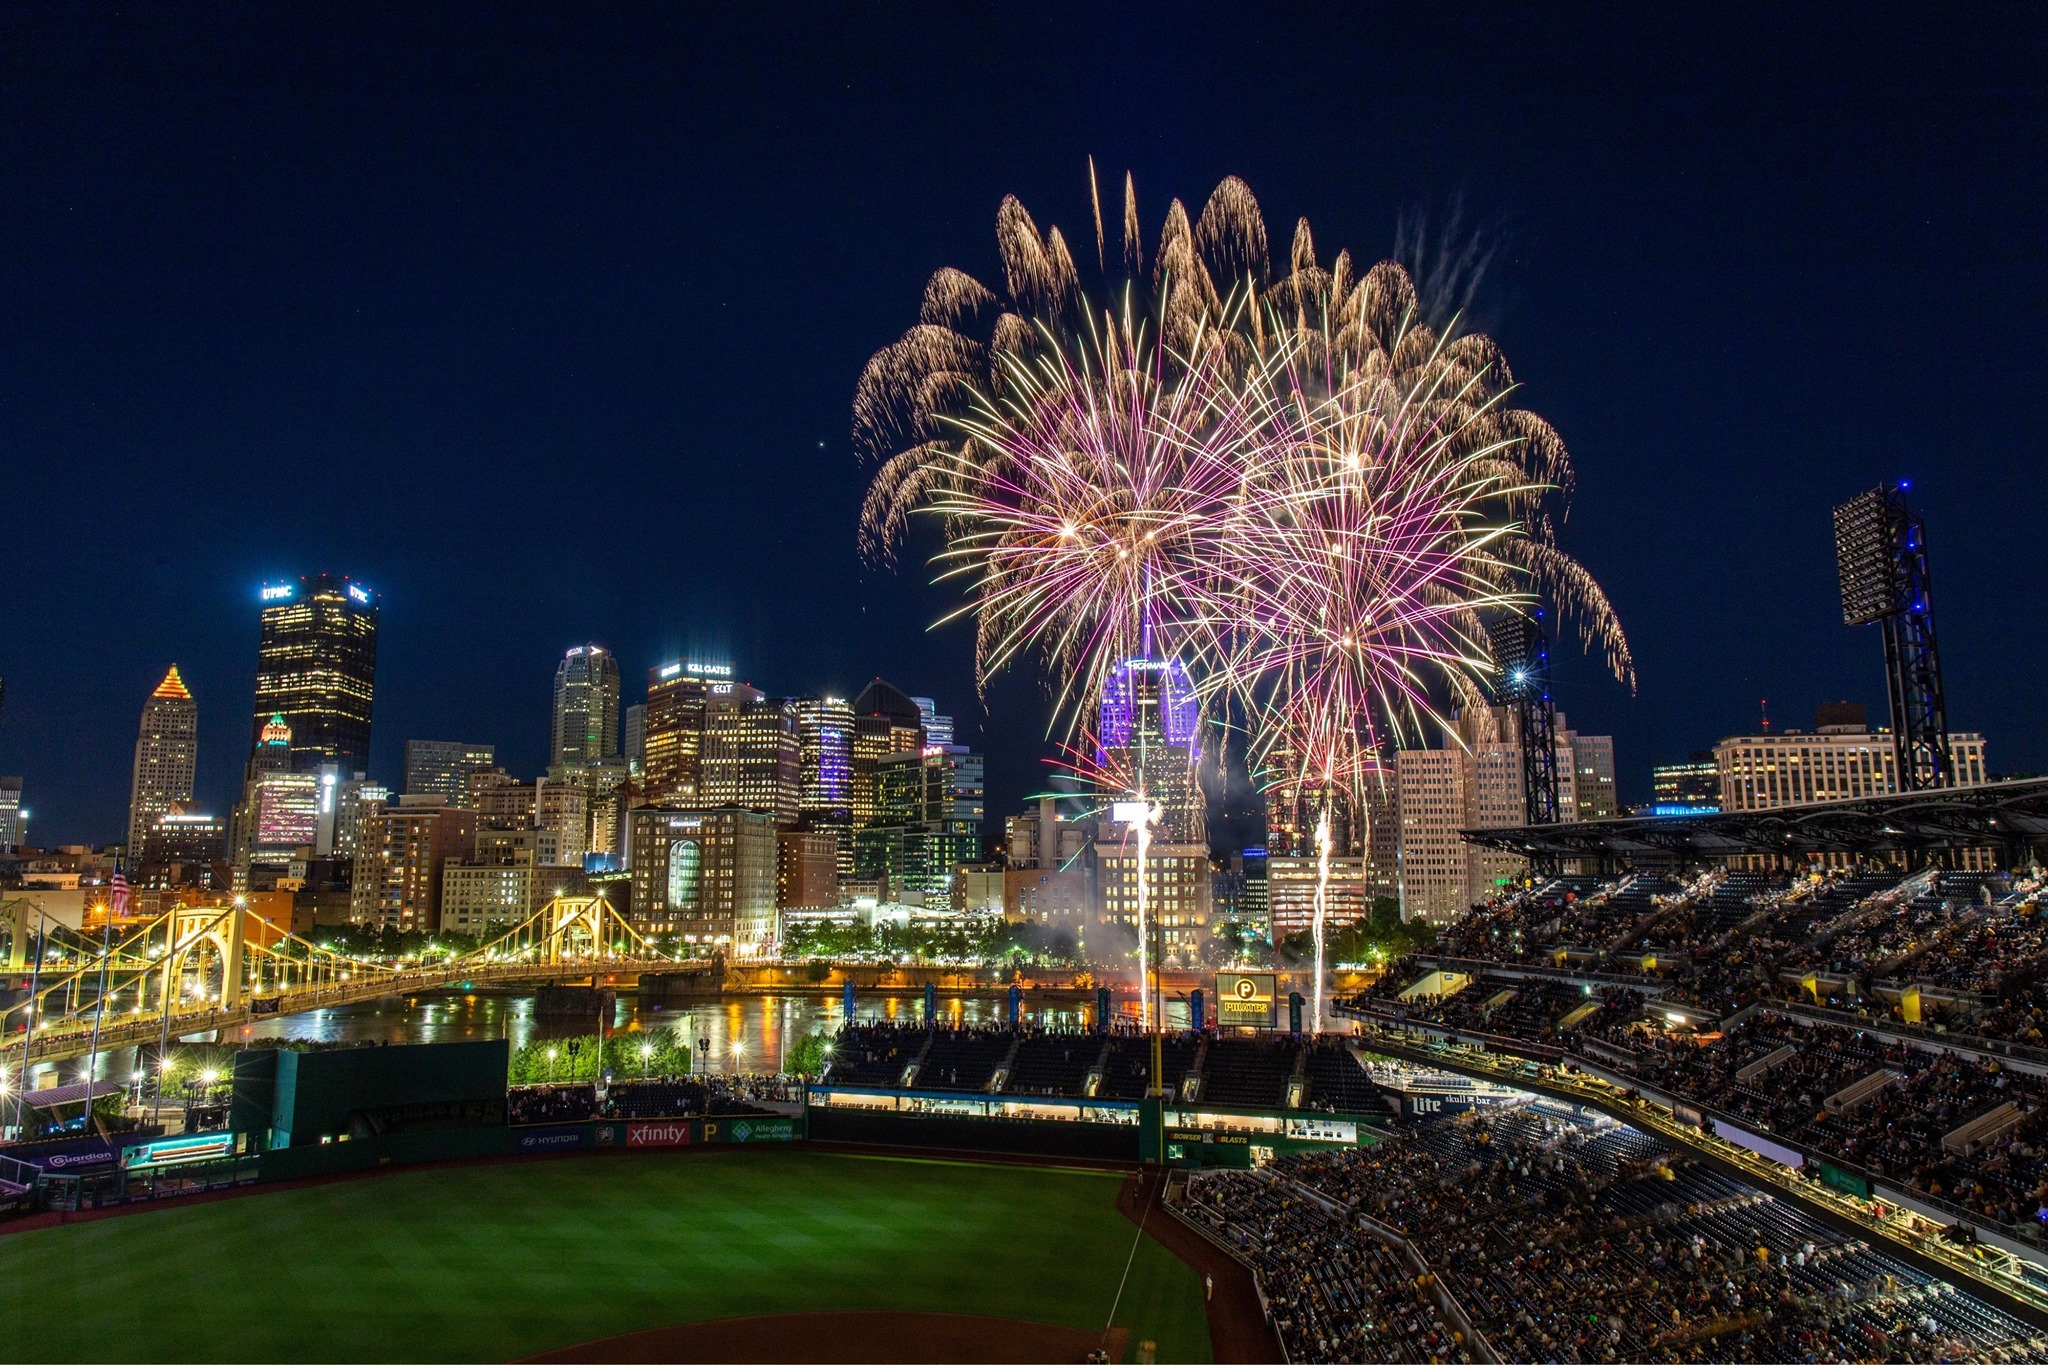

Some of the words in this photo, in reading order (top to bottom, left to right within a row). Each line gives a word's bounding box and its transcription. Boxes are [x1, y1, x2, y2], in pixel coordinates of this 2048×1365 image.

[263, 586, 292, 600] UPMC
[687, 663, 704, 673] K&L
[704, 665, 731, 675] GATES
[713, 684, 733, 694] EQT
[833, 698, 846, 706] PNC
[1224, 1002, 1268, 1012] PIRATES
[1445, 1094, 1466, 1104] skull
[1476, 1095, 1491, 1105] bar
[1412, 1096, 1442, 1116] Lite
[631, 1124, 686, 1144] xfinity
[703, 1123, 717, 1142] P
[755, 1124, 793, 1134] Allegheny
[538, 1134, 578, 1144] HYUNDAI
[1173, 1132, 1202, 1141] BOWSER
[1220, 1136, 1248, 1144] BLASTS
[50, 1152, 112, 1167] Guardian
